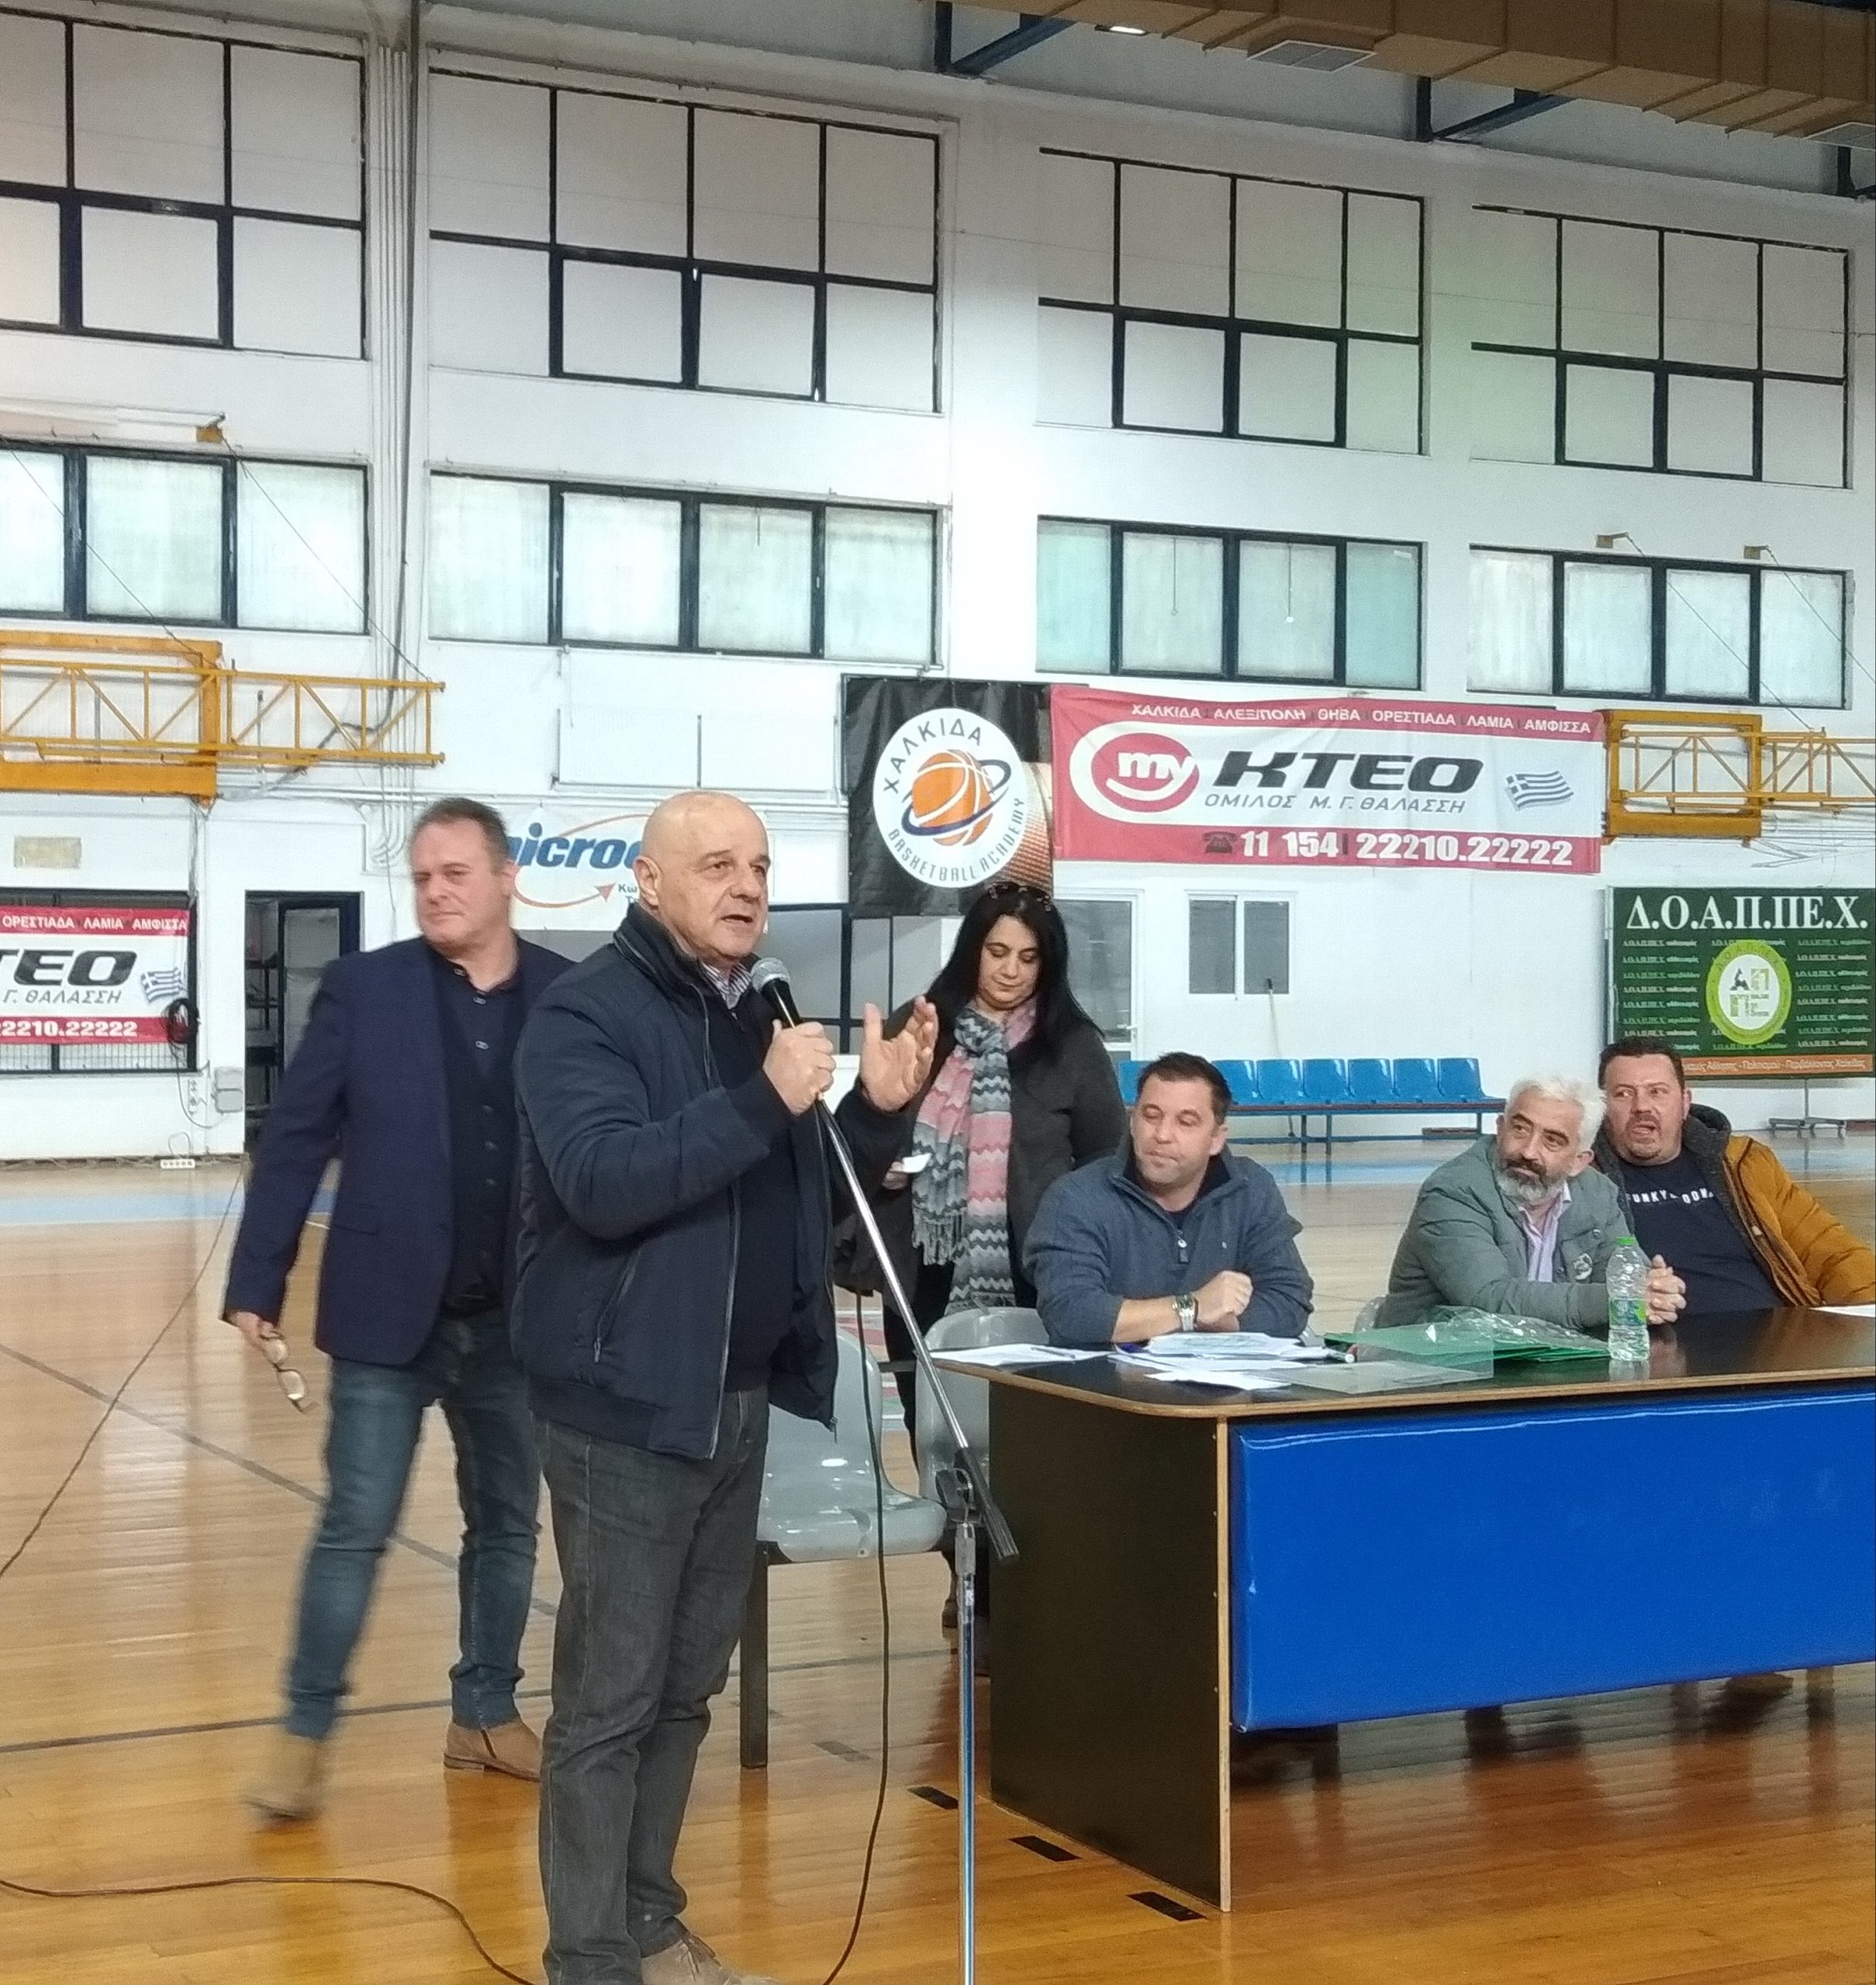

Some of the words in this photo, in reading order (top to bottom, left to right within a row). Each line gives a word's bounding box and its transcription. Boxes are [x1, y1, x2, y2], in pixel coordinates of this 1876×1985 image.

[1131, 704, 1201, 719] ΧΑΛΚΙΔΑ
[1318, 708, 1360, 721] ΘΗΒΑ
[1372, 709, 1456, 727] ΟΡΕΣΤΙΑΔΑ
[1467, 715, 1514, 730] ΛΑΜΙΑ
[1524, 719, 1591, 734] ΑΜΦΙΣΣΑ
[883, 717, 983, 795] ΧΑΛΚΙΔΑ
[1118, 750, 1194, 782] my
[1212, 751, 1484, 792] ΚΤΕΟ
[1204, 793, 1297, 810] ΟΜΙΛΟΣ
[1359, 796, 1466, 814] ΘΑΛΑΣΣΗ
[1240, 830, 1270, 858] 11
[1281, 831, 1339, 858] 154
[1356, 833, 1572, 866] 22210.22222
[2, 915, 75, 929] ΟΡΕΣΤΙΑΔΑ
[83, 917, 124, 930] ΛΑΜΙΑ
[131, 917, 188, 930] ΑΜΦΙΣΣΑ
[1626, 895, 1869, 930] Δ.Ο.Α.Π.ΠΕ.Χ.
[25, 989, 122, 1004] ΘΑΛΑΣΣΗ
[0, 1020, 138, 1037] 2210.22222
